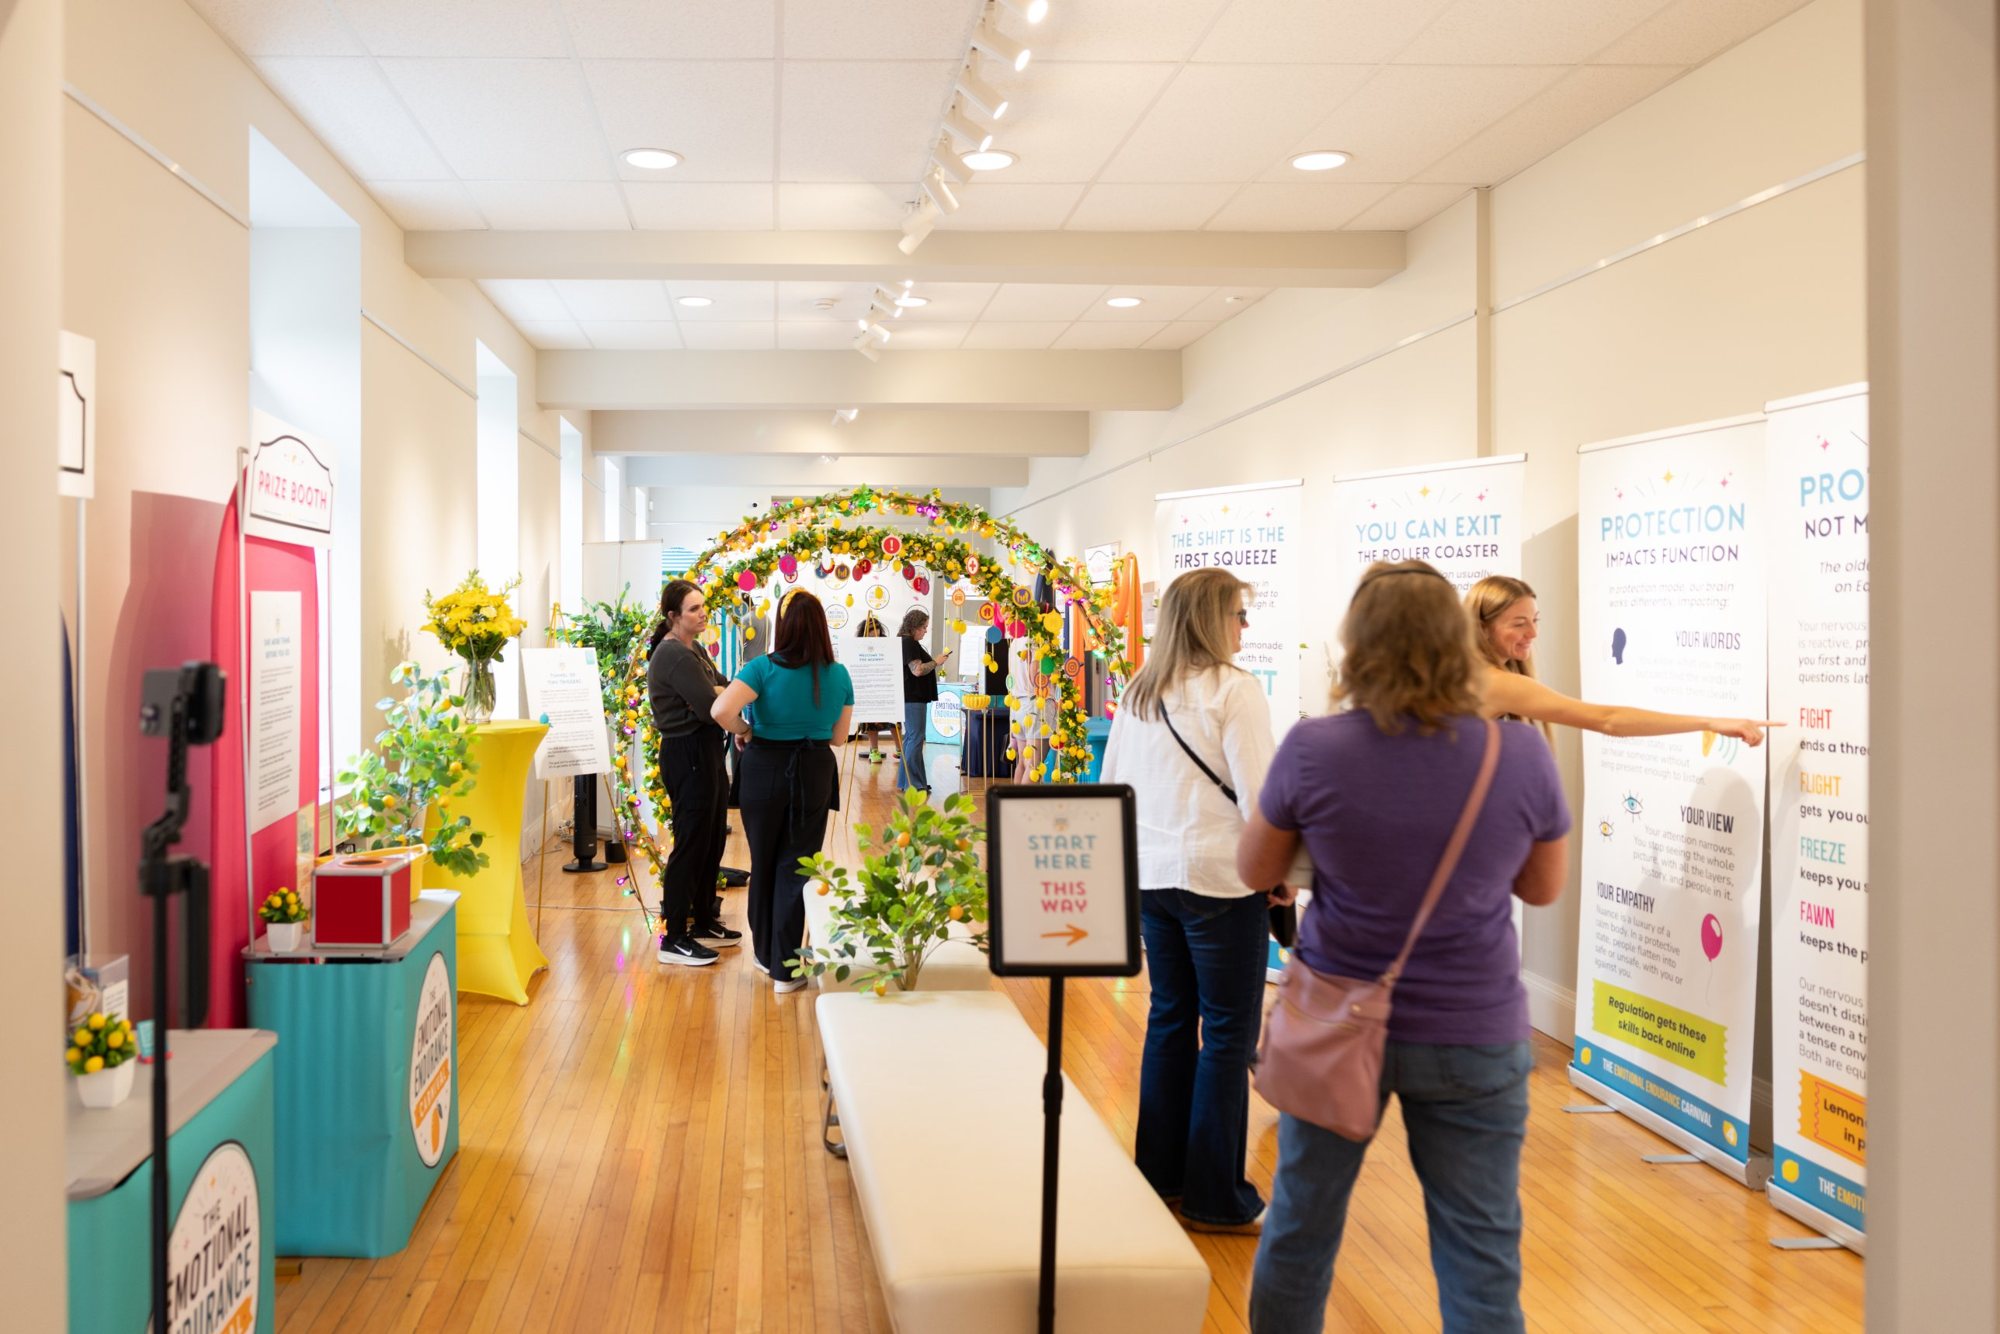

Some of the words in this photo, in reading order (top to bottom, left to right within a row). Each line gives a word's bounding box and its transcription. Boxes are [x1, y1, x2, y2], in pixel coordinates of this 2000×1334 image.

[258, 470, 287, 500] PRIZE
[291, 481, 328, 510] BOOTH
[1356, 521, 1397, 543] YOU
[1405, 517, 1447, 539] CAN
[1456, 514, 1502, 537] EXIT
[1601, 503, 1745, 541] PROTECTION
[1804, 516, 1845, 540] NOT
[1171, 532, 1192, 548] THE
[1198, 529, 1234, 546] SHIFT
[1240, 528, 1252, 543] IS
[1257, 526, 1285, 542] THE
[1174, 552, 1208, 569] FIRST
[1213, 549, 1277, 566] SQUEEZE
[1358, 550, 1377, 562] THE
[1383, 546, 1430, 561] ROLLER
[1435, 544, 1499, 559] COASTER
[1606, 549, 1656, 568] IMPACTS
[1662, 544, 1739, 564] FUNCTION
[1456, 569, 1493, 580] usually
[1820, 561, 1841, 574] The
[1271, 590, 1279, 598] to
[1706, 580, 1735, 591] brain
[1834, 581, 1852, 593] on
[1798, 619, 1818, 632] Your
[1821, 621, 1866, 632] nervous
[1241, 640, 1283, 650] lemonade
[1675, 630, 1700, 648] YOUR
[1702, 632, 1741, 650] WORDS
[1239, 654, 1256, 662] with
[1259, 654, 1273, 663] the
[1798, 656, 1815, 669] you
[1818, 654, 1840, 666] first
[1844, 654, 1866, 667] and
[1798, 672, 1850, 685] questions
[1800, 707, 1832, 730] FIGHT
[1800, 738, 1825, 751] ends
[1828, 741, 1837, 753] a
[1661, 754, 1690, 768] without
[1800, 771, 1841, 797] FLIGHT
[1680, 805, 1704, 829] YOUR
[1706, 810, 1735, 834] VIEW
[1800, 804, 1822, 819] gets
[1828, 808, 1853, 823] you
[1028, 835, 1097, 850] START
[1645, 825, 1660, 837] Your
[1662, 828, 1697, 846] attention
[1699, 840, 1735, 856] narrows.
[1800, 836, 1846, 865] FREEZE
[1035, 854, 1091, 869] HERE
[1633, 835, 1647, 847] You
[1648, 840, 1664, 852] stop
[1666, 844, 1690, 860] seeing
[1693, 850, 1705, 864] the
[1707, 854, 1735, 871] whole
[1661, 857, 1677, 869] with
[1679, 860, 1689, 872] all
[1691, 863, 1704, 876] the
[1705, 867, 1734, 888] layers,
[1800, 866, 1833, 886] keeps
[1837, 875, 1860, 892] you
[1041, 881, 1086, 895] THIS
[1596, 880, 1614, 901] YOUR
[1616, 887, 1655, 914] EMPATHY
[1669, 874, 1684, 886] and
[1686, 878, 1712, 897] people
[1713, 886, 1721, 897] in
[1723, 888, 1733, 901] it.
[1041, 899, 1088, 913] WAY
[1800, 900, 1835, 930] FAWN
[1621, 912, 1627, 923] is
[1627, 917, 1632, 925] a
[1633, 916, 1655, 934] luxury
[1657, 925, 1666, 935] of
[1666, 930, 1671, 939] a
[1611, 923, 1628, 940] body.
[1631, 929, 1637, 939] In
[1638, 934, 1643, 942] a
[1645, 935, 1680, 956] protective
[1800, 931, 1833, 952] keeps
[1837, 941, 1858, 957] the
[1613, 938, 1636, 953] people
[1638, 943, 1661, 961] flatten
[1663, 954, 1677, 969] into
[1595, 958, 1617, 974] against
[1618, 966, 1632, 979] you.
[1608, 950, 1615, 958] or
[1616, 953, 1641, 970] unsafe,
[1643, 962, 1659, 976] with
[1660, 969, 1674, 984] you
[1675, 975, 1683, 986] or
[1799, 976, 1816, 994] Our
[1819, 985, 1864, 1008] nervous
[1799, 994, 1838, 1018] doesn't
[1609, 995, 1655, 1023] Regulation
[1656, 1014, 1677, 1031] gets
[1679, 1021, 1707, 1043] these
[1799, 1013, 1845, 1037] between
[1849, 1031, 1856, 1041] a
[1618, 1019, 1639, 1036] skills
[1641, 1027, 1664, 1046] back
[1666, 1038, 1696, 1059] online
[1799, 1030, 1805, 1040] a
[1807, 1033, 1837, 1051] tense
[1799, 1043, 1822, 1064] Both
[1825, 1056, 1843, 1071] are
[1603, 1058, 1614, 1074] THE
[1614, 1065, 1645, 1090] EMOTIONAL
[1645, 1079, 1680, 1109] ENDURANCE
[1681, 1100, 1712, 1128] CARNIVAL
[1824, 1098, 1867, 1128] Lemon
[1844, 1127, 1855, 1144] in
[1819, 1176, 1836, 1199] THE
[203, 1199, 221, 1234] THE
